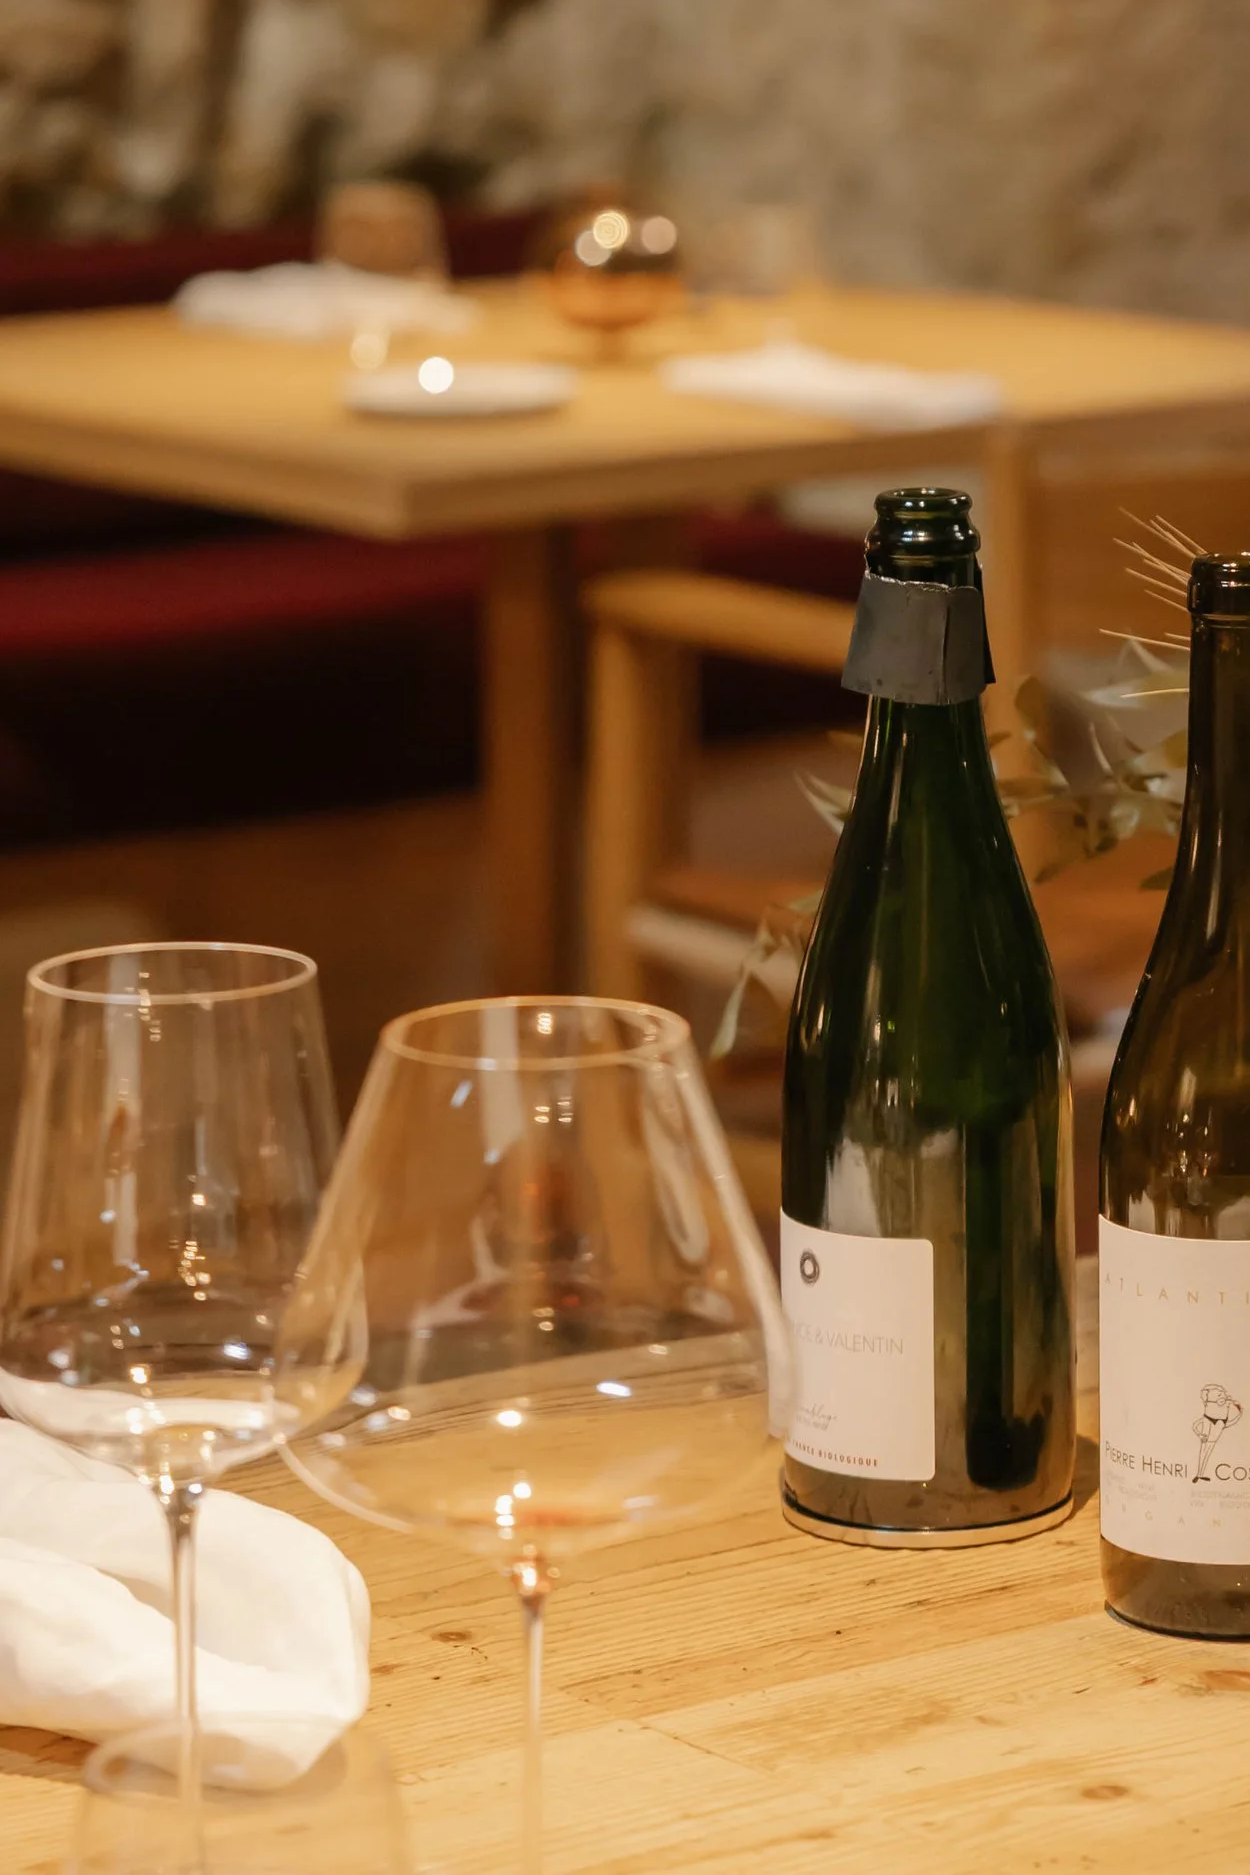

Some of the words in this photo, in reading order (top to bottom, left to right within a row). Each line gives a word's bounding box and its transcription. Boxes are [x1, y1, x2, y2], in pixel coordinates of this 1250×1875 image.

[825, 1331, 904, 1356] VALENTIN
[817, 1448, 879, 1468] BIOLOGIQUE
[1141, 1454, 1188, 1479] HENRI
